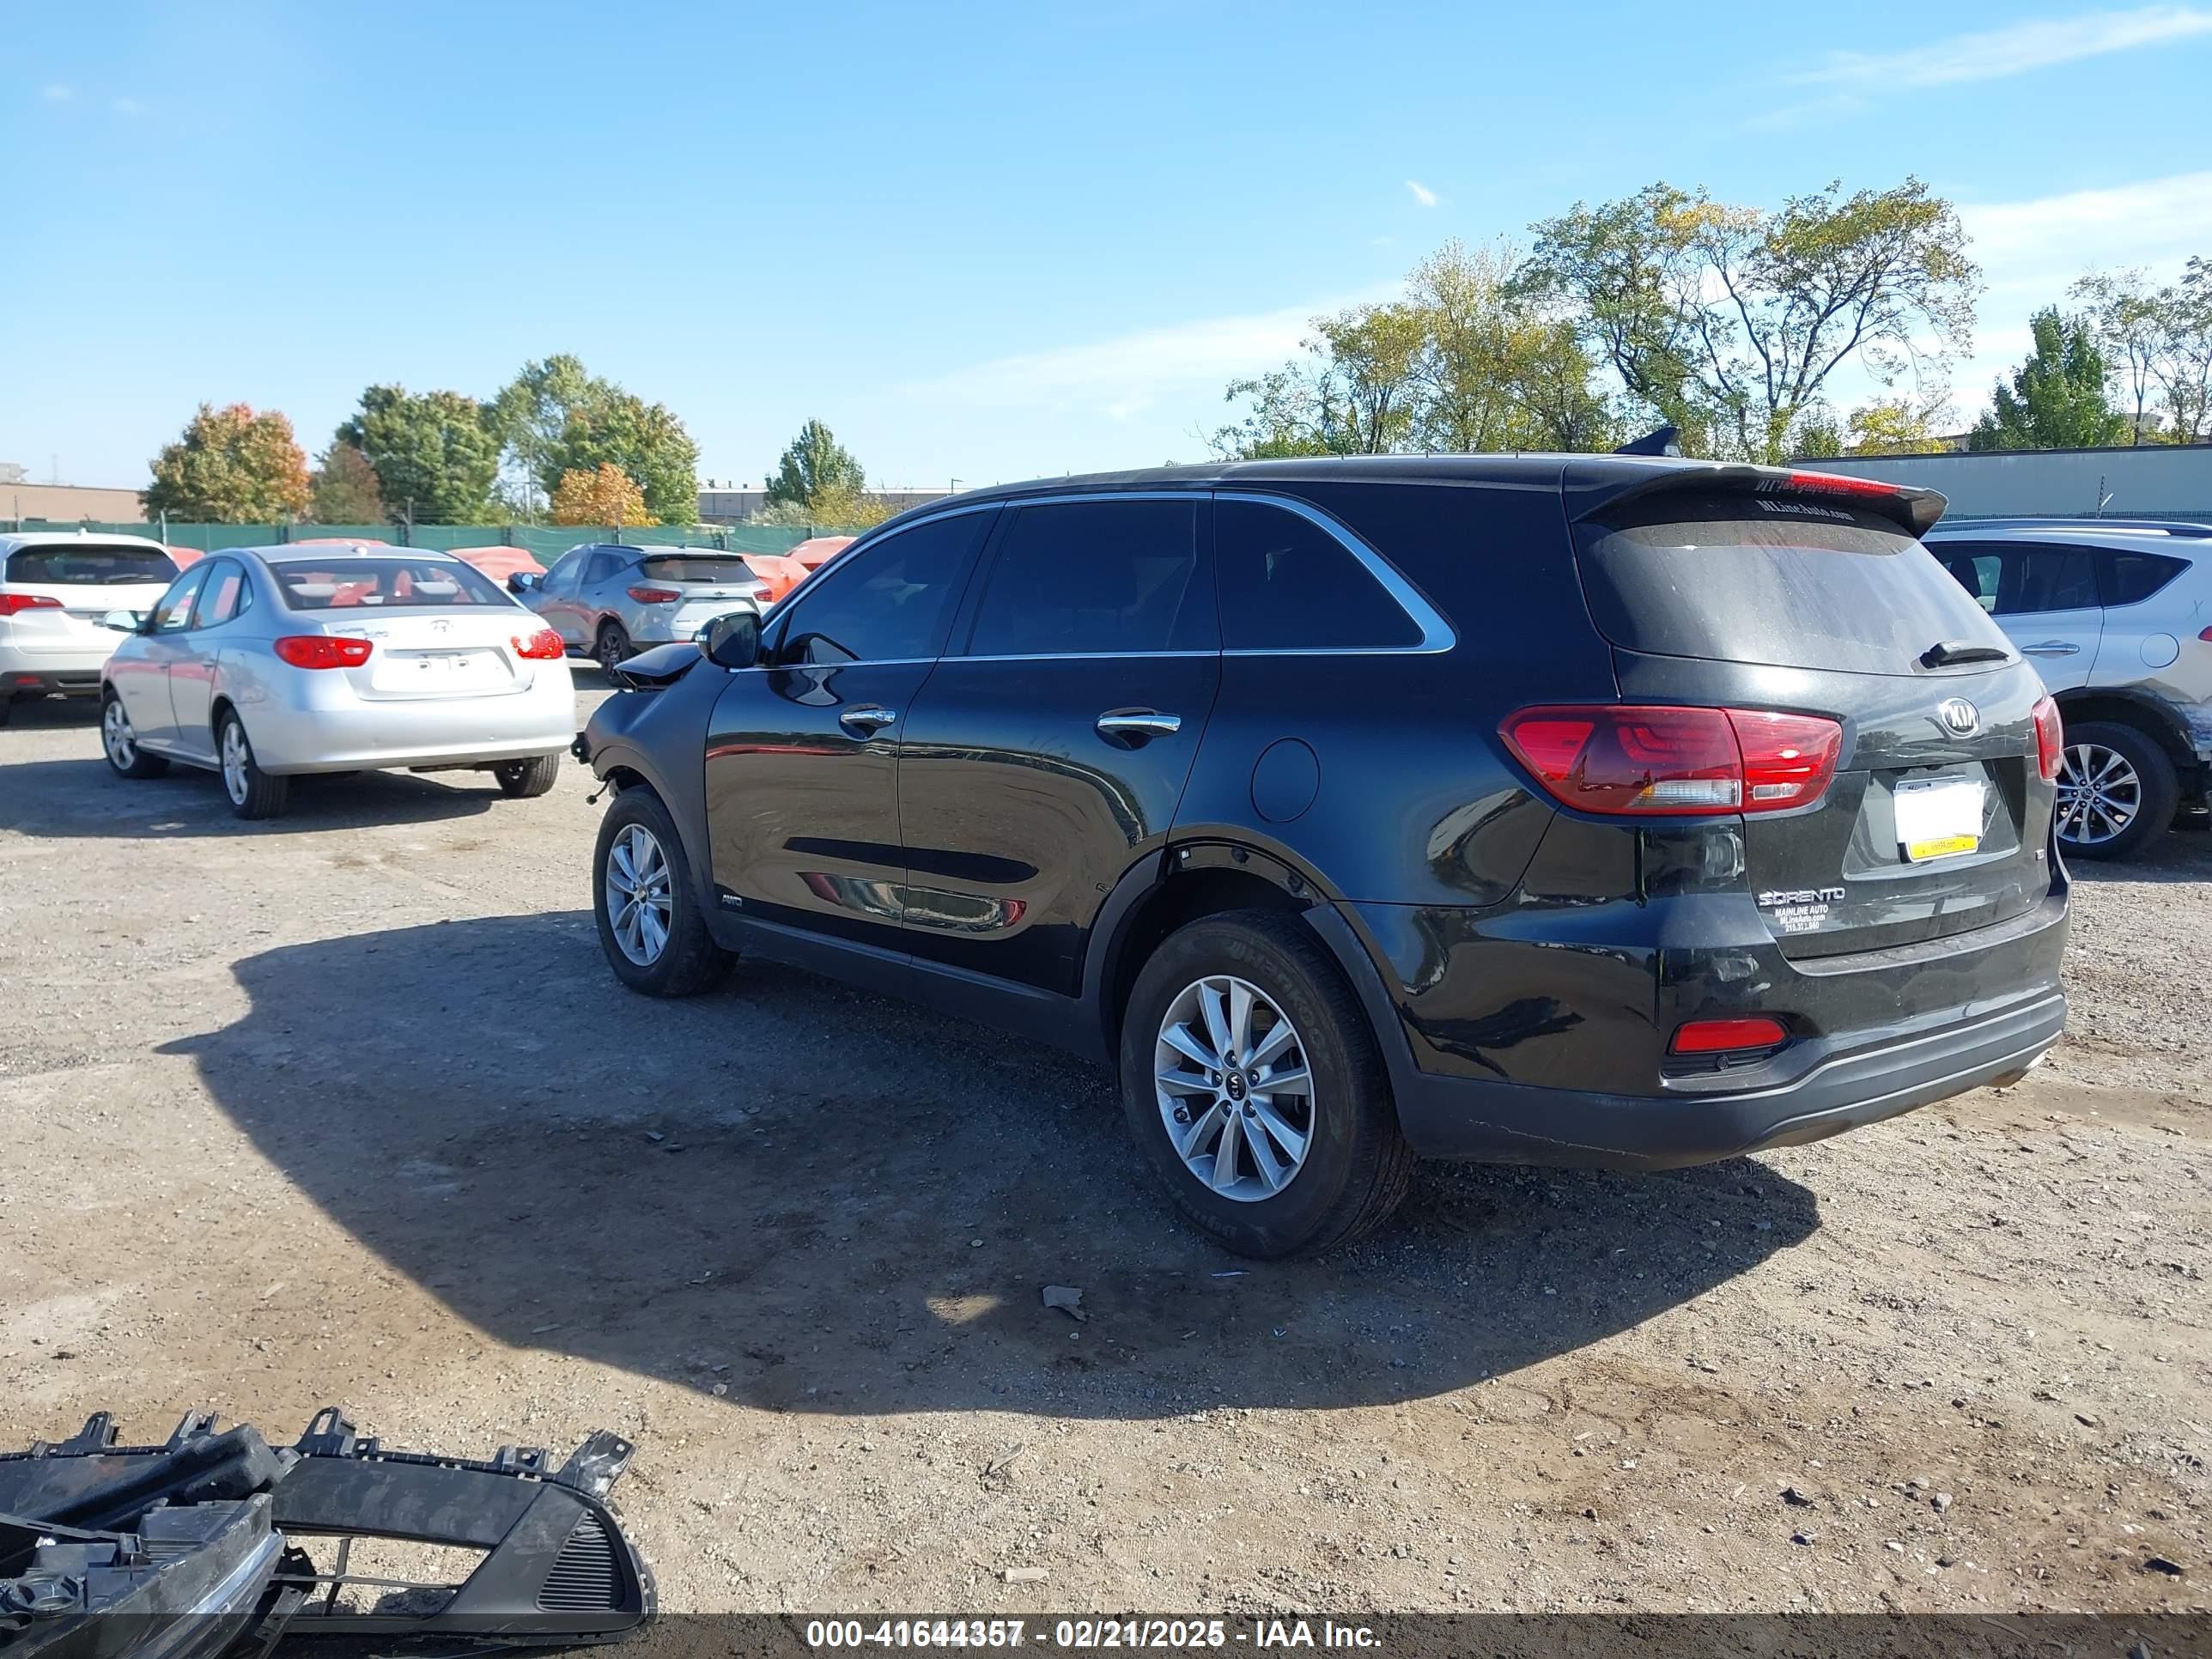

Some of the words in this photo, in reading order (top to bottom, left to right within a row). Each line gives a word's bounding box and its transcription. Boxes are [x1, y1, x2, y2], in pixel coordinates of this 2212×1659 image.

[1755, 499, 1856, 521] MLineAuto.com
[1949, 705, 1976, 727] KIA
[722, 894, 743, 908] AWD
[1758, 887, 1846, 907] SORENTO
[1774, 906, 1809, 918] MAINLINE
[1809, 904, 1829, 915] AUTO
[1779, 915, 1826, 926] MLineAuto.com
[1231, 1075, 1240, 1098] KIA
